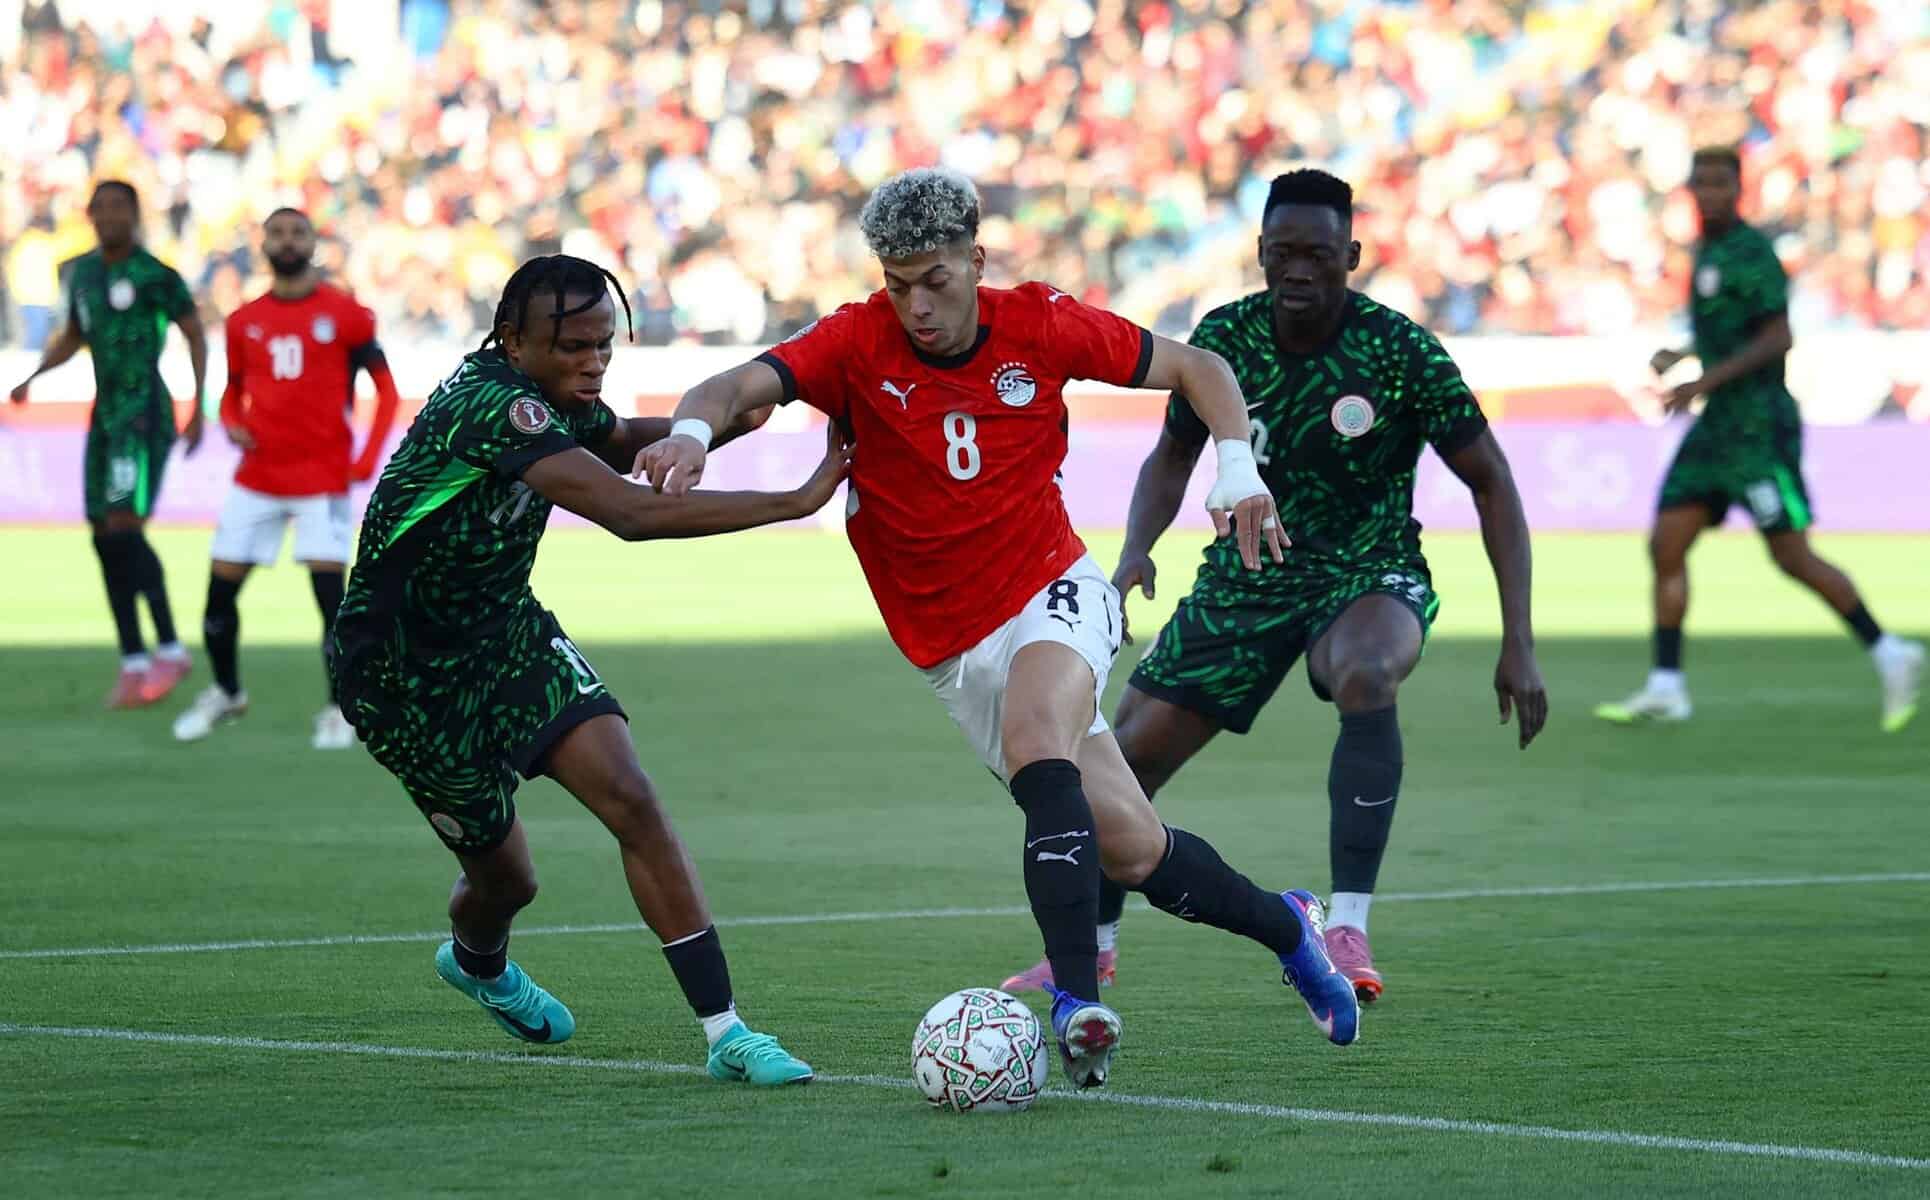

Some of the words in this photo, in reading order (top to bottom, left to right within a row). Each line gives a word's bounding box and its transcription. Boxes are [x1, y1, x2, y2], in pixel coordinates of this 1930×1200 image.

[267, 334, 304, 381] 10
[943, 411, 981, 480] 8
[1046, 579, 1079, 615] 8
